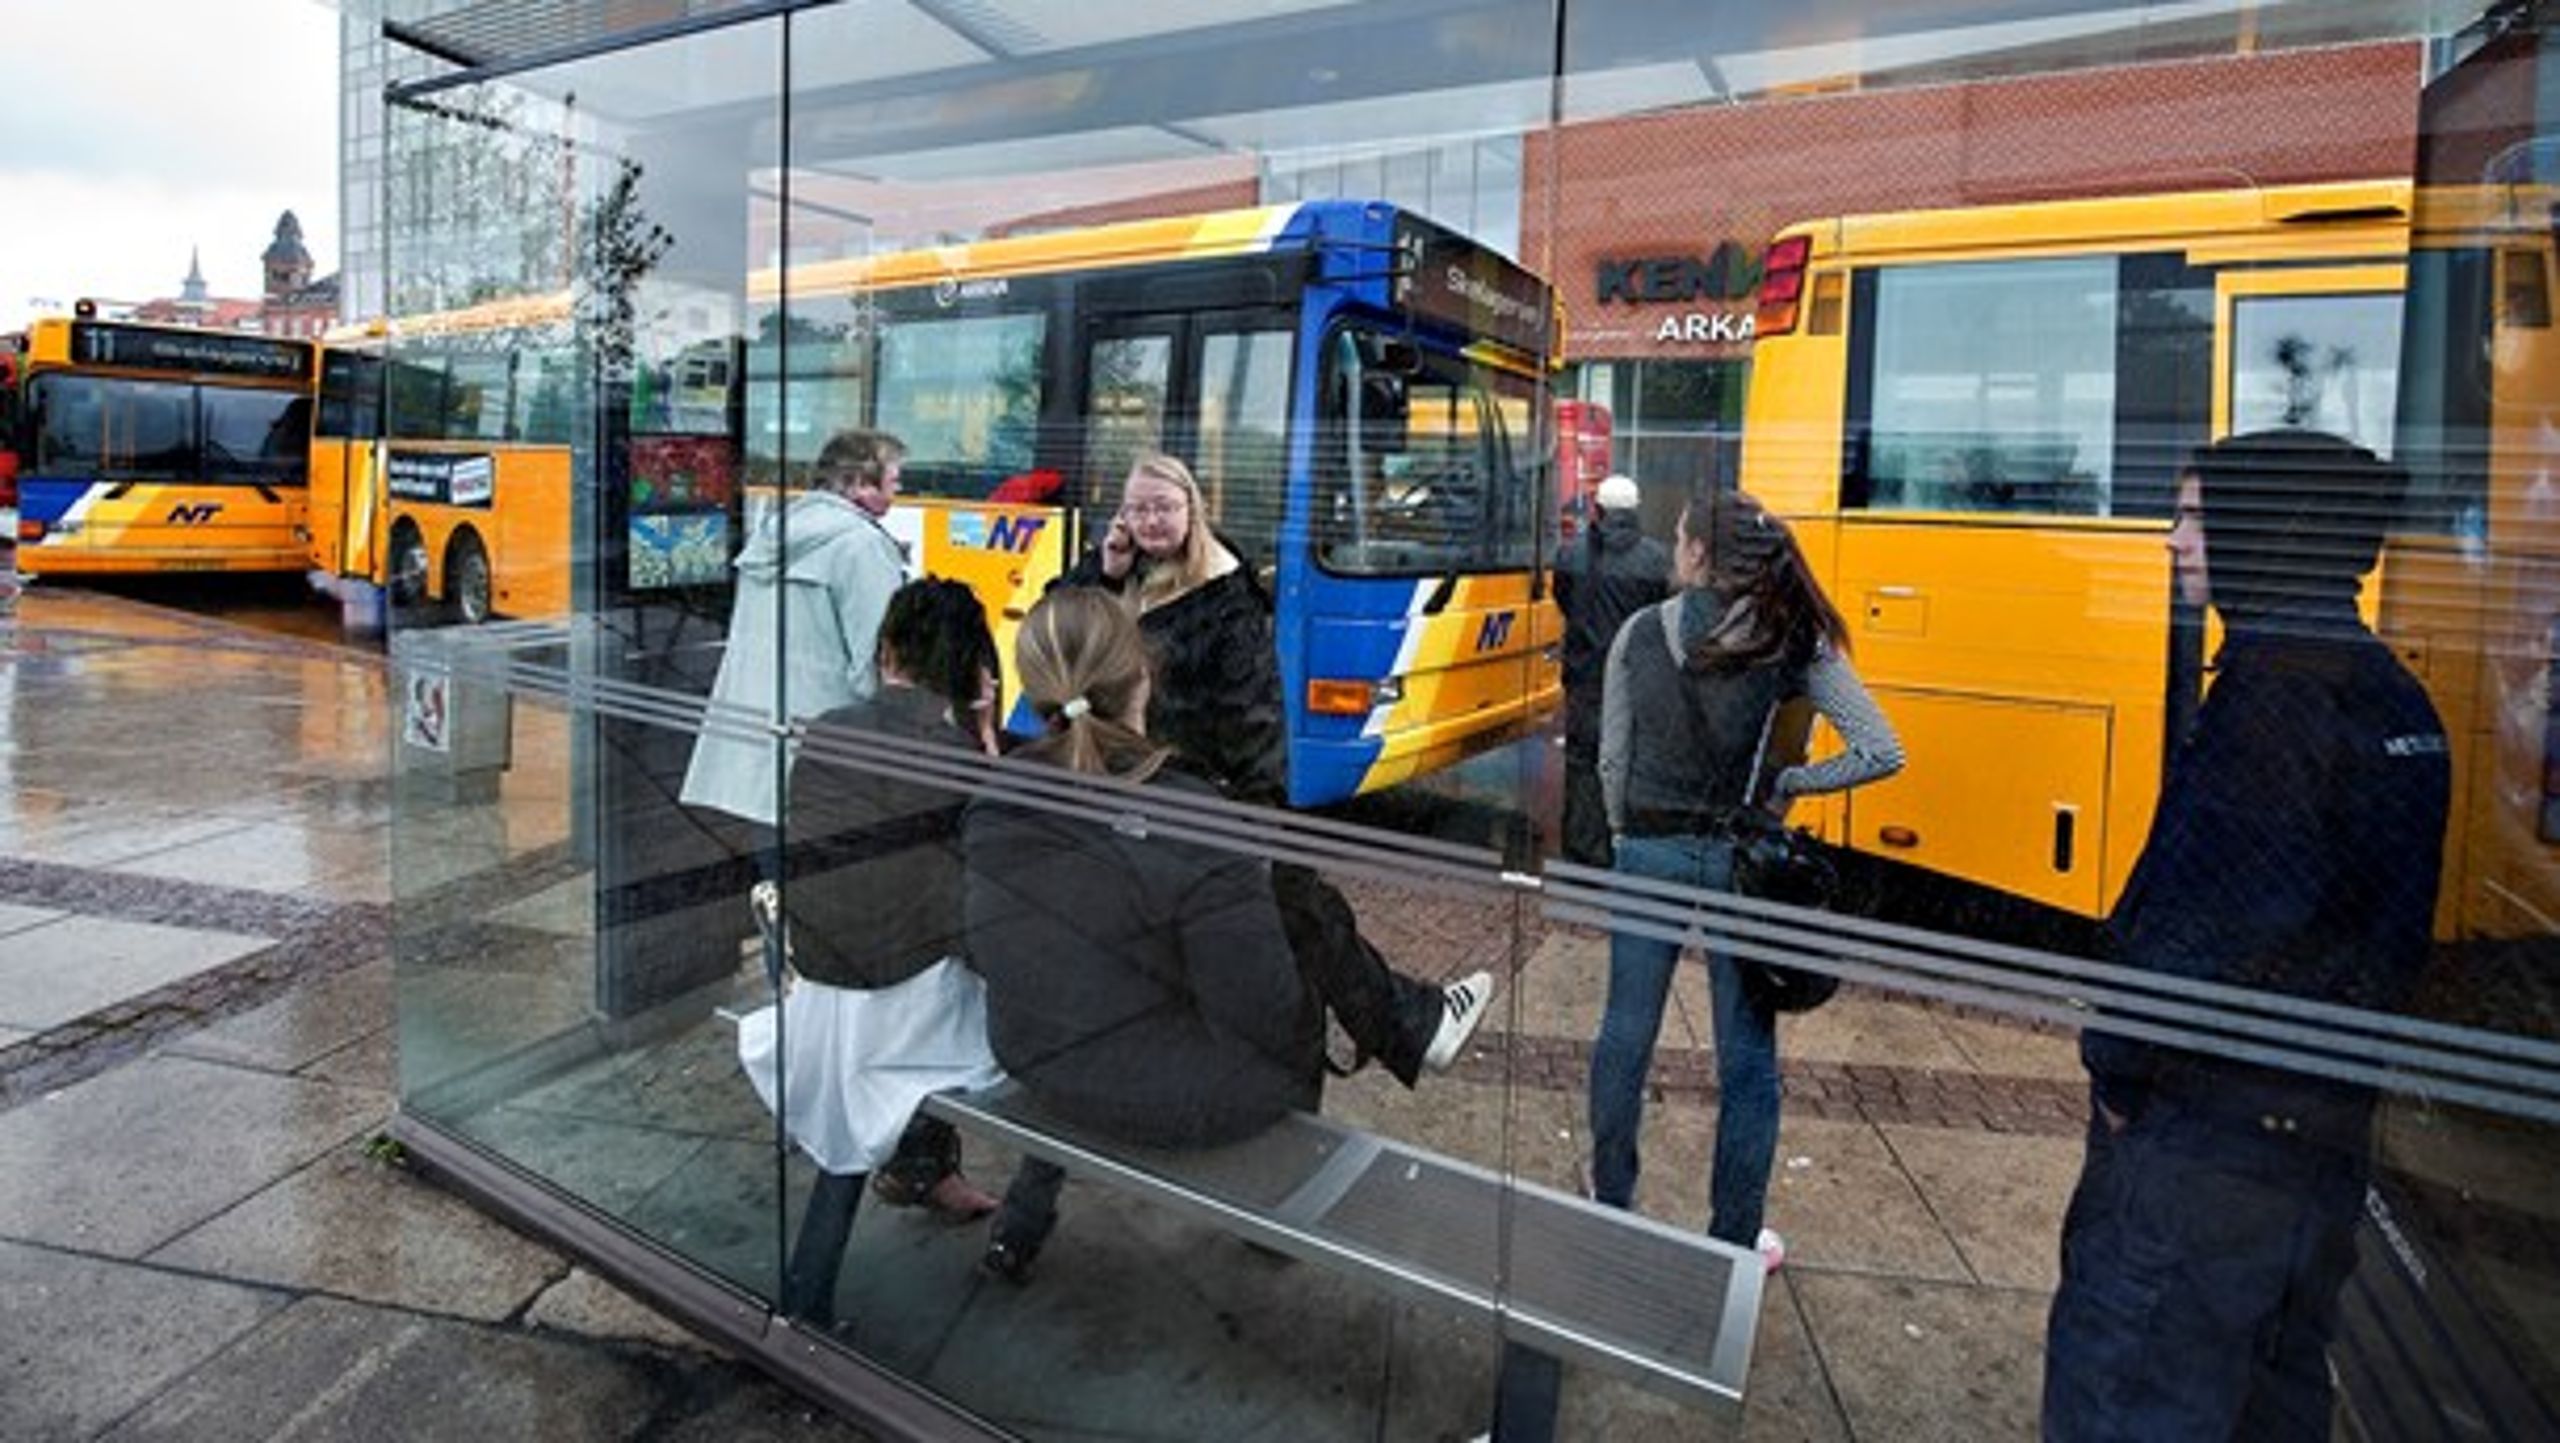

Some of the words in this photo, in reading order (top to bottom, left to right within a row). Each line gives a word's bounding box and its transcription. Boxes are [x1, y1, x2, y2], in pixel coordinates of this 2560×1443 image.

[1657, 314, 1755, 341] ARKA
[85, 331, 115, 361] 11
[167, 504, 224, 523] NT
[986, 515, 1046, 552] NT
[1476, 611, 1515, 650] NT
